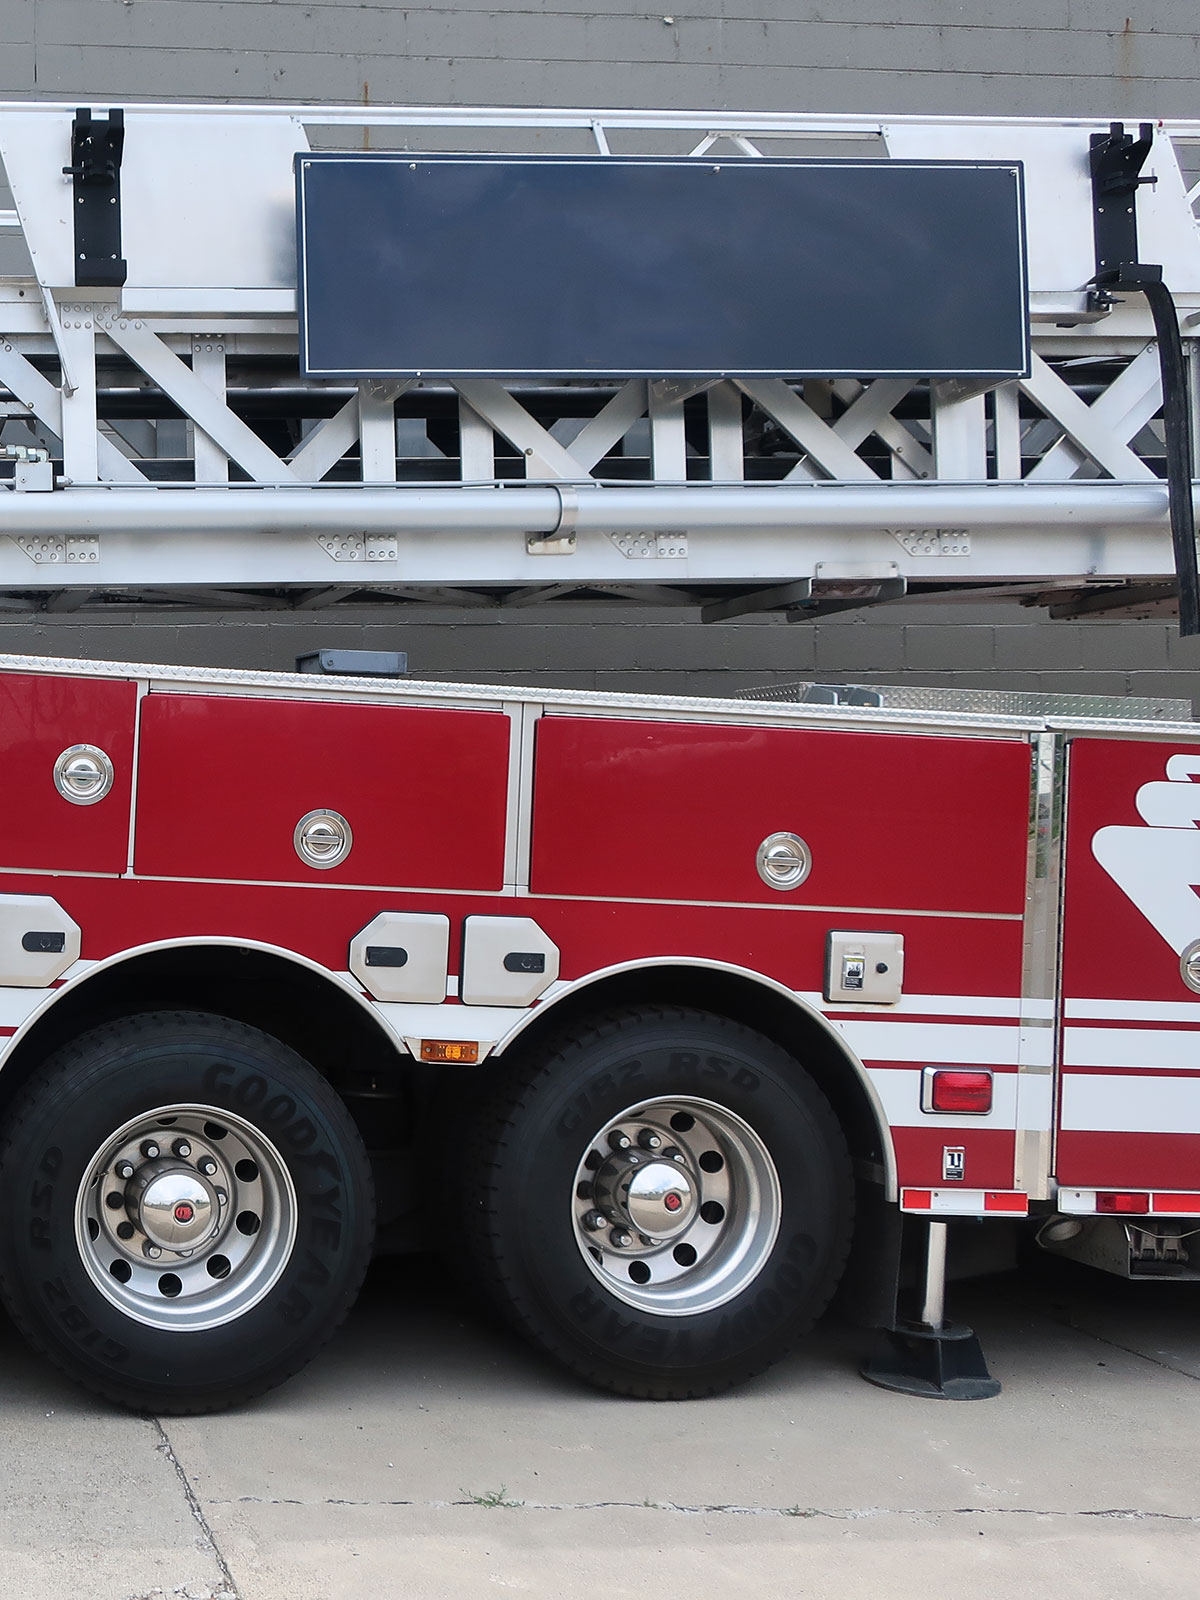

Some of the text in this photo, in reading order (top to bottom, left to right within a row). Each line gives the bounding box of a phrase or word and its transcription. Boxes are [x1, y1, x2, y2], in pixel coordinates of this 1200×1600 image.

[668, 1052, 761, 1092] RSD
[30, 1146, 63, 1252] RSD
[202, 1062, 342, 1326] GOODYEAR
